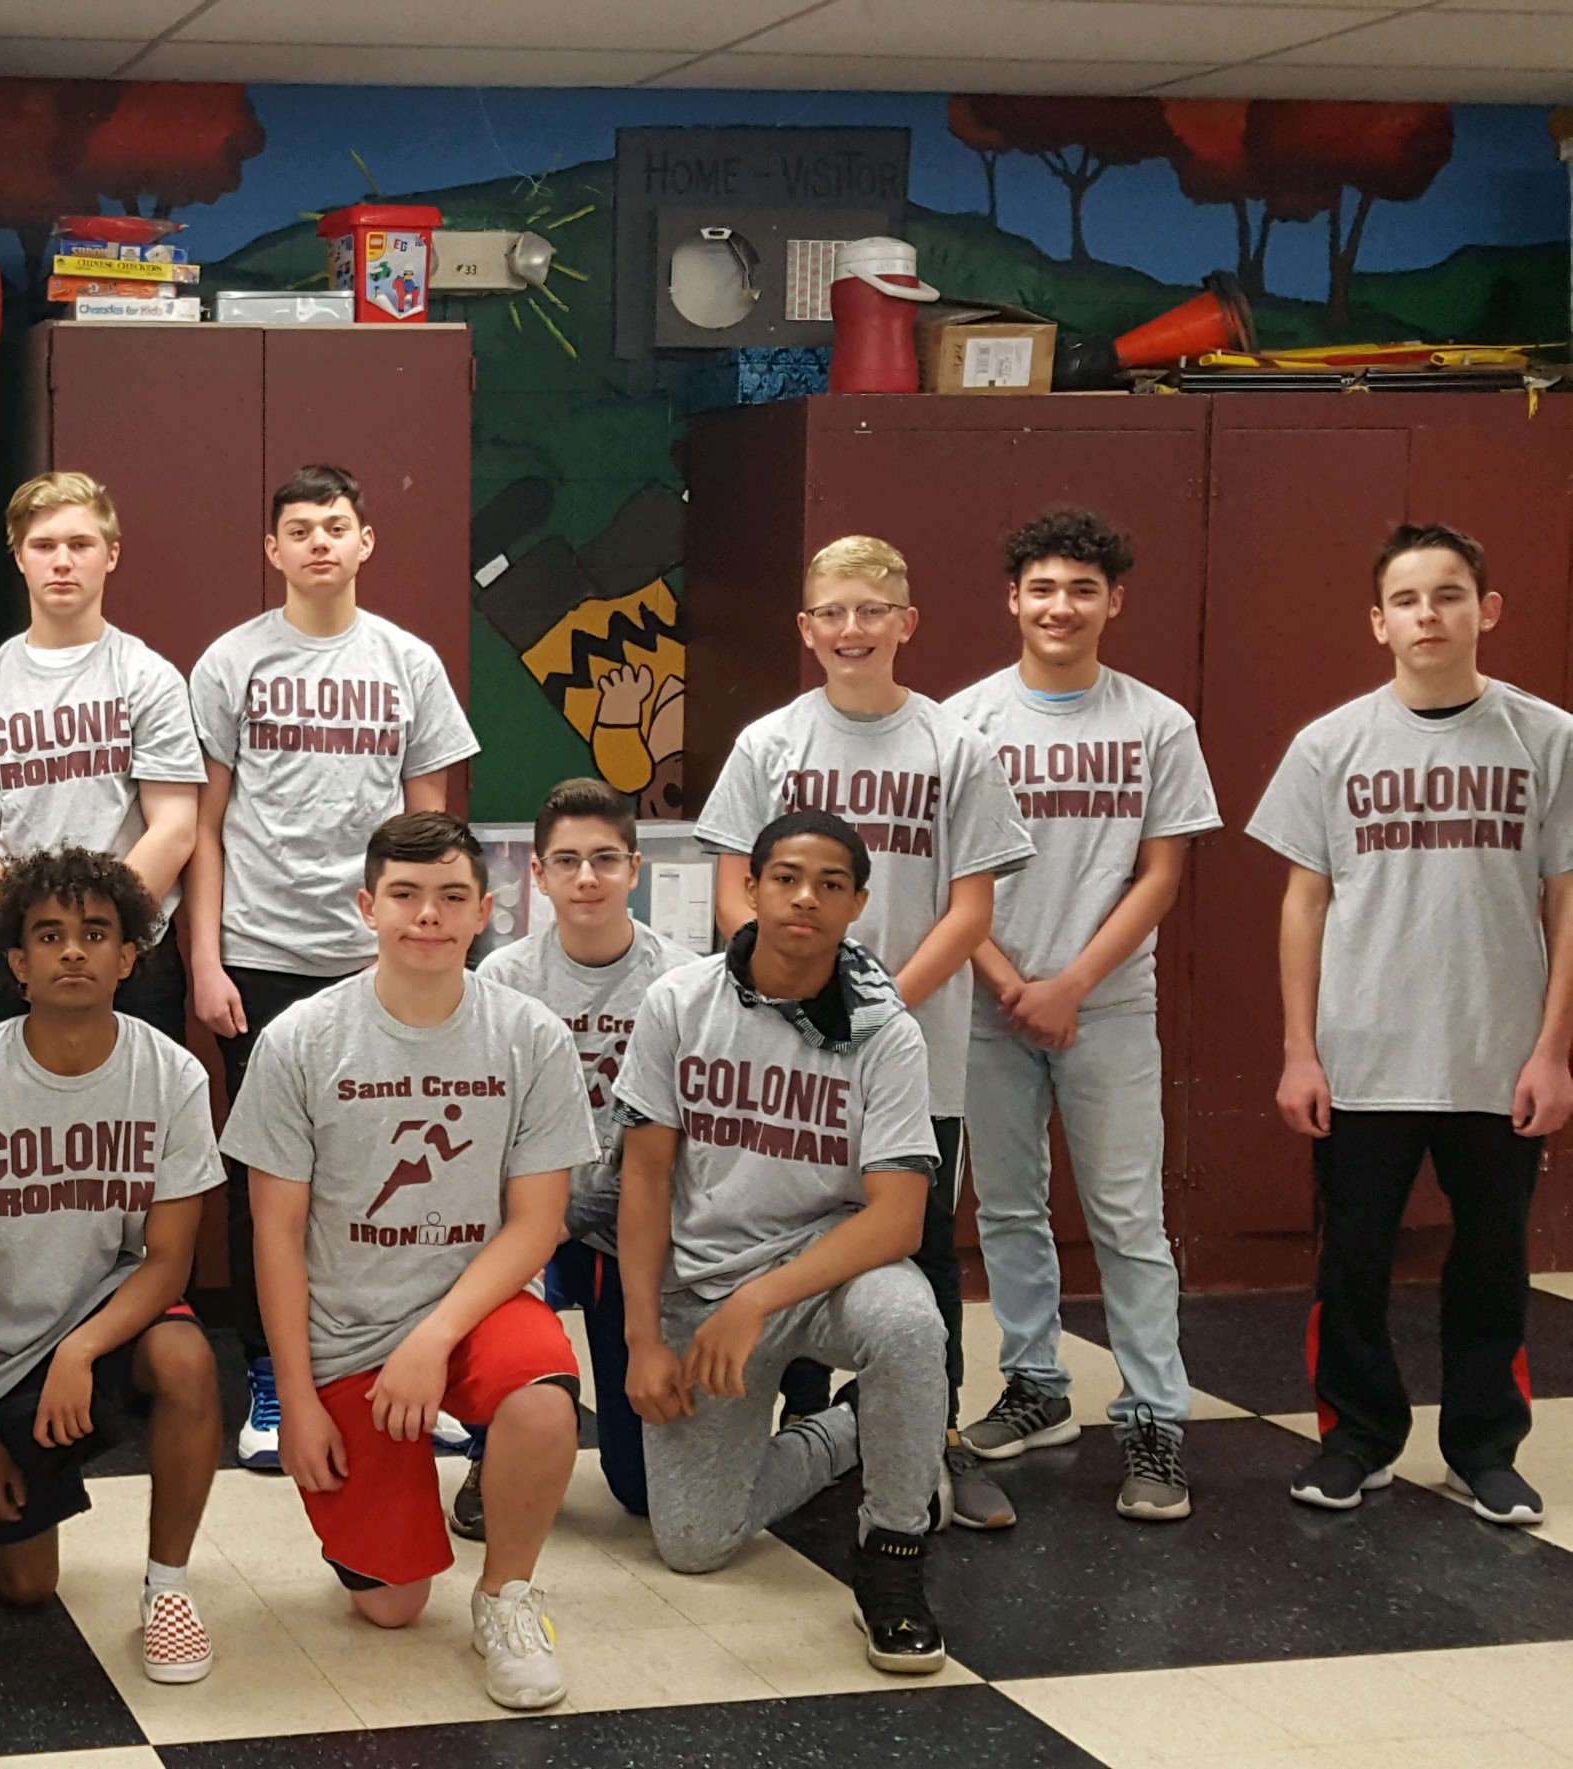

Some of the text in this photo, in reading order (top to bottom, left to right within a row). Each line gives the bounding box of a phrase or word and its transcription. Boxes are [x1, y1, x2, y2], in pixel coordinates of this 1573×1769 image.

[644, 149, 741, 196] HOME
[782, 150, 900, 200] VISITOR
[77, 259, 115, 268] CHINESE
[117, 261, 163, 272] CHECKERS
[78, 304, 164, 316] Charades for Kids
[246, 676, 401, 722] COLONIE
[249, 722, 400, 756] IRONMAN
[998, 741, 1142, 786] OLONIE
[1014, 790, 1143, 820] ONMAN
[1346, 766, 1530, 819] COLONIE
[1355, 818, 1524, 855] IRONMAN
[597, 1014, 635, 1034] Cre
[337, 1075, 506, 1101] Sand Creek
[680, 1055, 851, 1130] COLONIE
[683, 1106, 849, 1167] IRONMAN
[349, 1216, 486, 1248] IRONMAN
